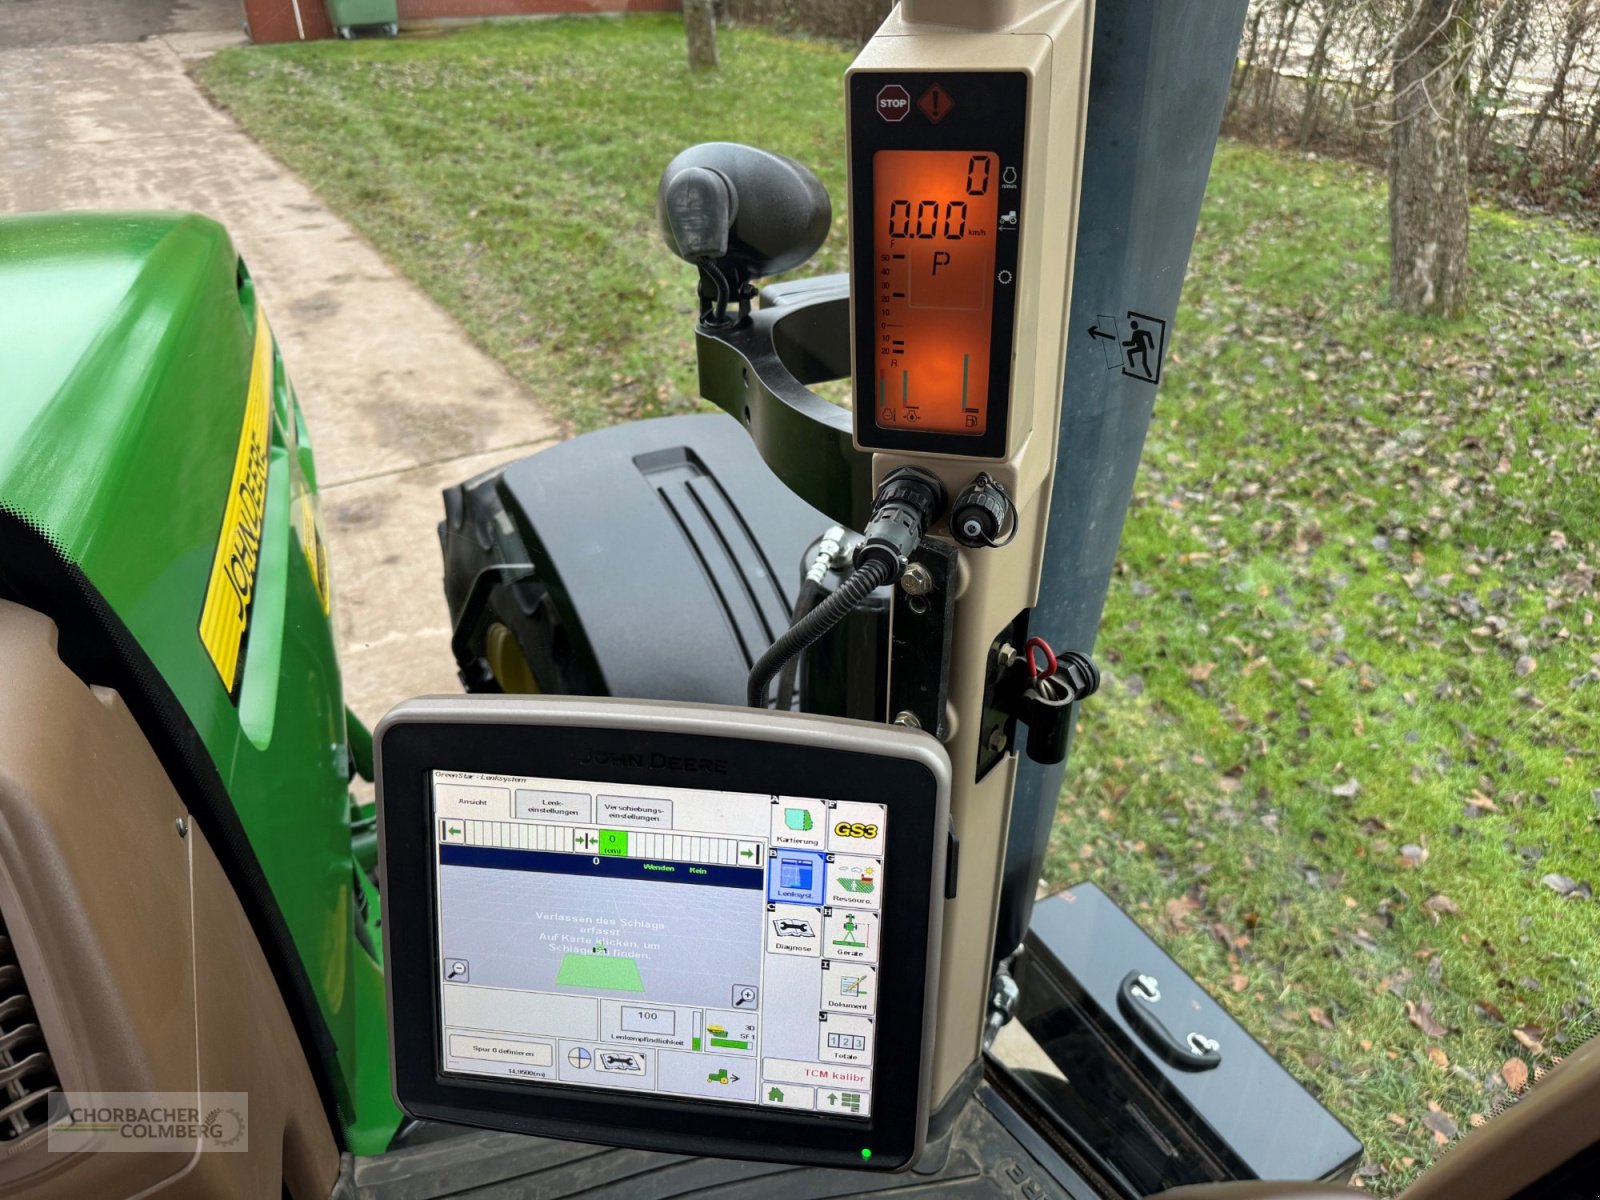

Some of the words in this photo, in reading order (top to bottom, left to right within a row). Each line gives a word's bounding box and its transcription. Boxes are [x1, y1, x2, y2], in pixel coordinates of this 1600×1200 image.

[880, 99, 907, 108] STOP
[966, 155, 990, 196] 0
[888, 200, 967, 239] 0.00
[968, 229, 987, 237] km/h
[881, 254, 890, 262] 50
[932, 251, 950, 276] P
[881, 295, 890, 303] 20
[881, 347, 890, 355] 20
[239, 430, 268, 528] DEERE
[223, 507, 262, 619] JOHN
[579, 750, 643, 768] JOHN
[650, 751, 729, 774] DEERE
[435, 771, 473, 780] GreenStar
[458, 798, 487, 806] Ansicht
[527, 807, 579, 816] einstellungen
[604, 803, 664, 814] Verschiebungs-
[608, 813, 660, 822] einstellungen
[835, 821, 878, 839] GS3
[609, 835, 616, 843] 0
[777, 836, 819, 846] Kartierung
[592, 857, 600, 865] 0
[643, 863, 675, 872] Wenden
[689, 867, 707, 875] Kein
[536, 911, 592, 924] Verlassen
[596, 916, 616, 925] des
[620, 918, 665, 930] Schlags
[580, 926, 620, 936] erfasst
[539, 932, 558, 941] Auf
[561, 935, 591, 944] Karte
[775, 943, 812, 951] Diagnose
[828, 1000, 867, 1010] Dokument
[638, 1012, 657, 1020] 100
[834, 1052, 857, 1060] Totale
[804, 1068, 828, 1078] TCM
[832, 1072, 865, 1082] kalibr
